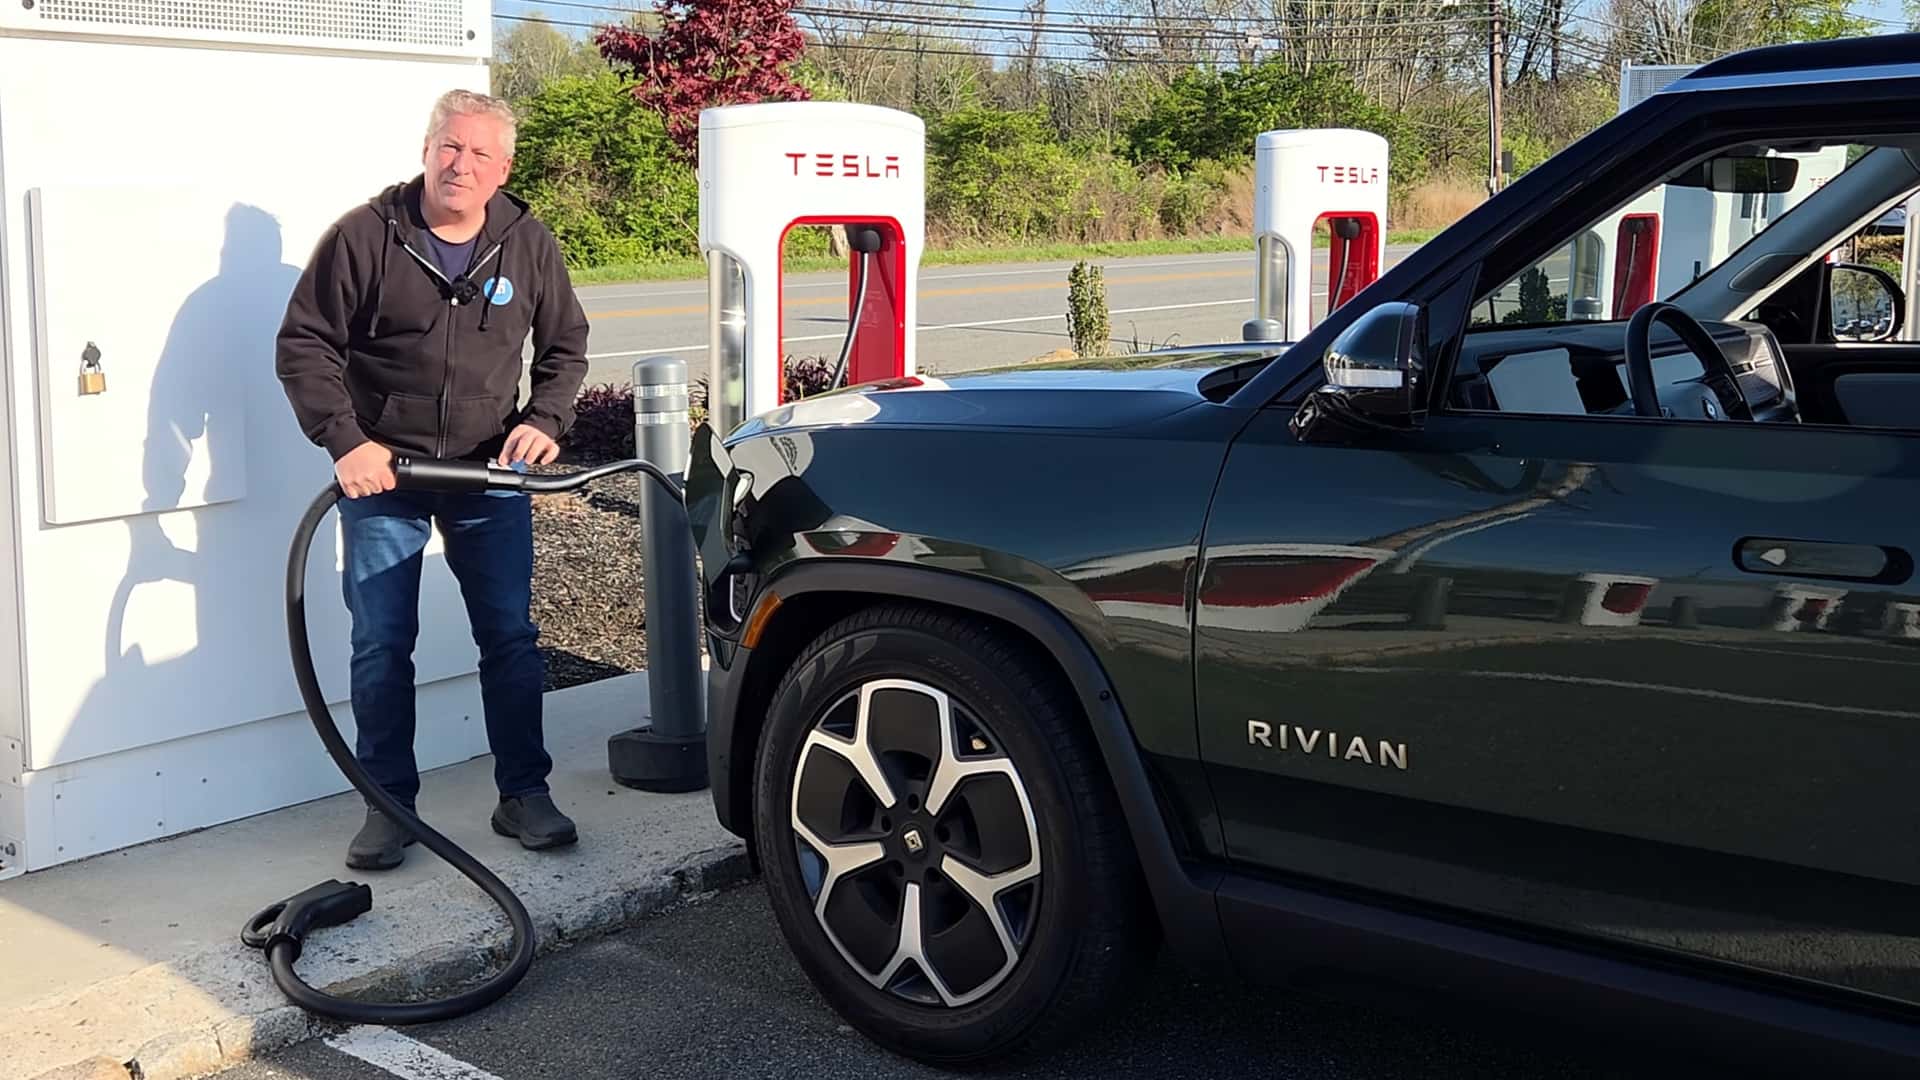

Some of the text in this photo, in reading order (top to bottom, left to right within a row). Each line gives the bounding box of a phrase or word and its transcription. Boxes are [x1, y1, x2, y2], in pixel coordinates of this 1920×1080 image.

[783, 152, 899, 179] TESLA
[1316, 165, 1378, 185] TESLA
[1247, 719, 1408, 770] RIVIAN
